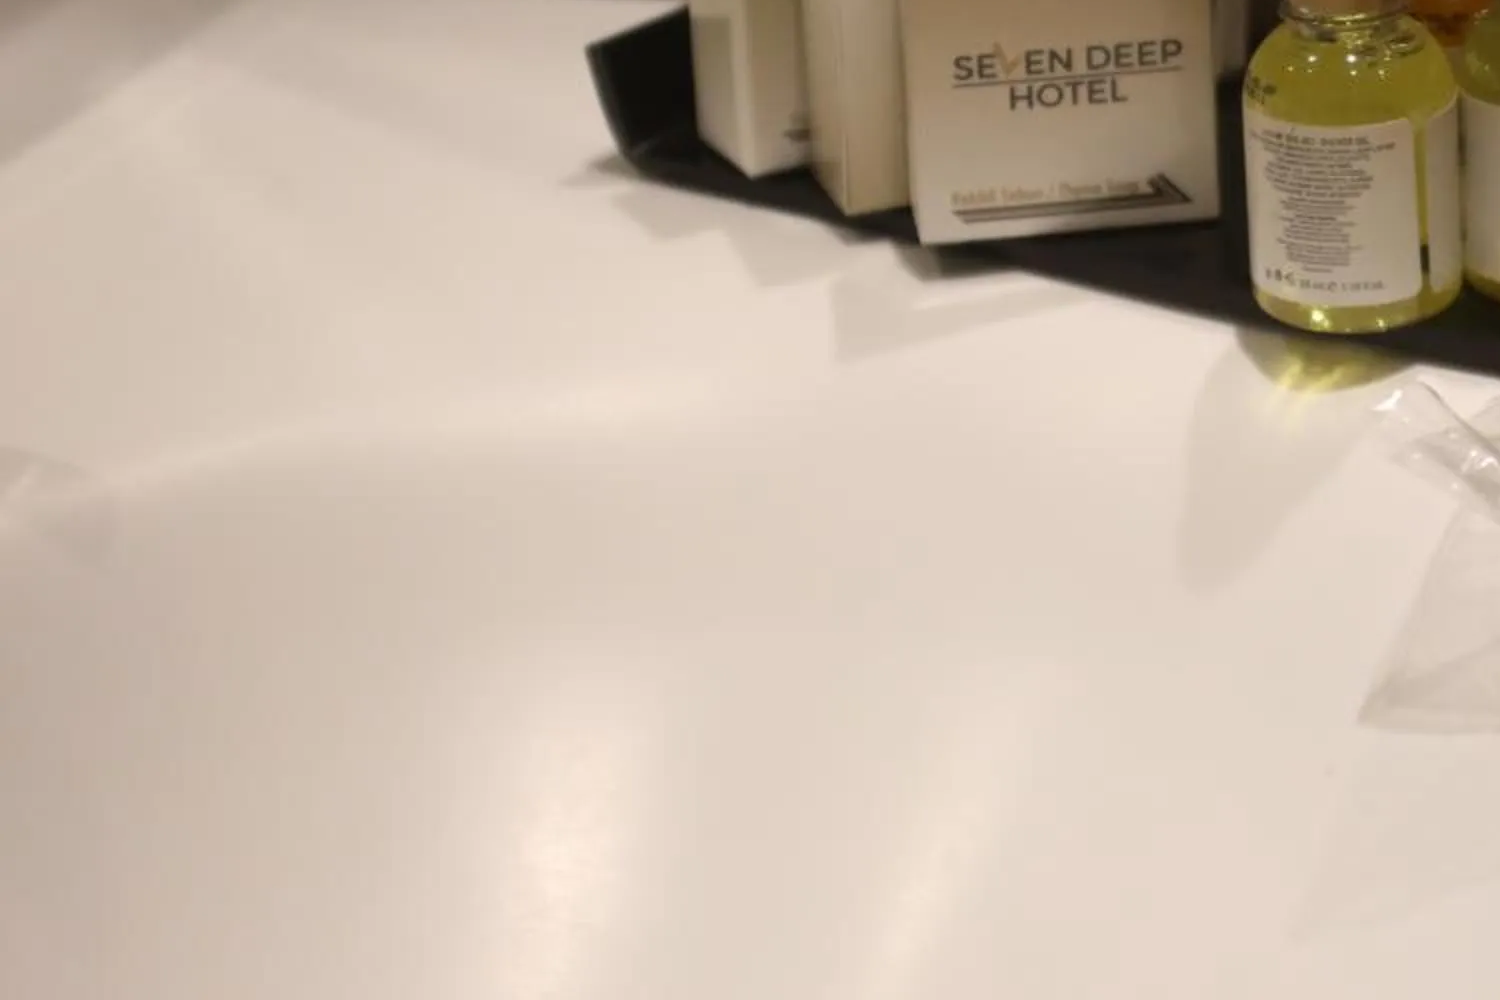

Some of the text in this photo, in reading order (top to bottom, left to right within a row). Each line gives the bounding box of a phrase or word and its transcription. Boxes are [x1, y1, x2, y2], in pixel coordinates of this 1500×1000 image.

[952, 39, 1183, 81] SEVEN DEEP
[1009, 78, 1128, 111] HOTEL
